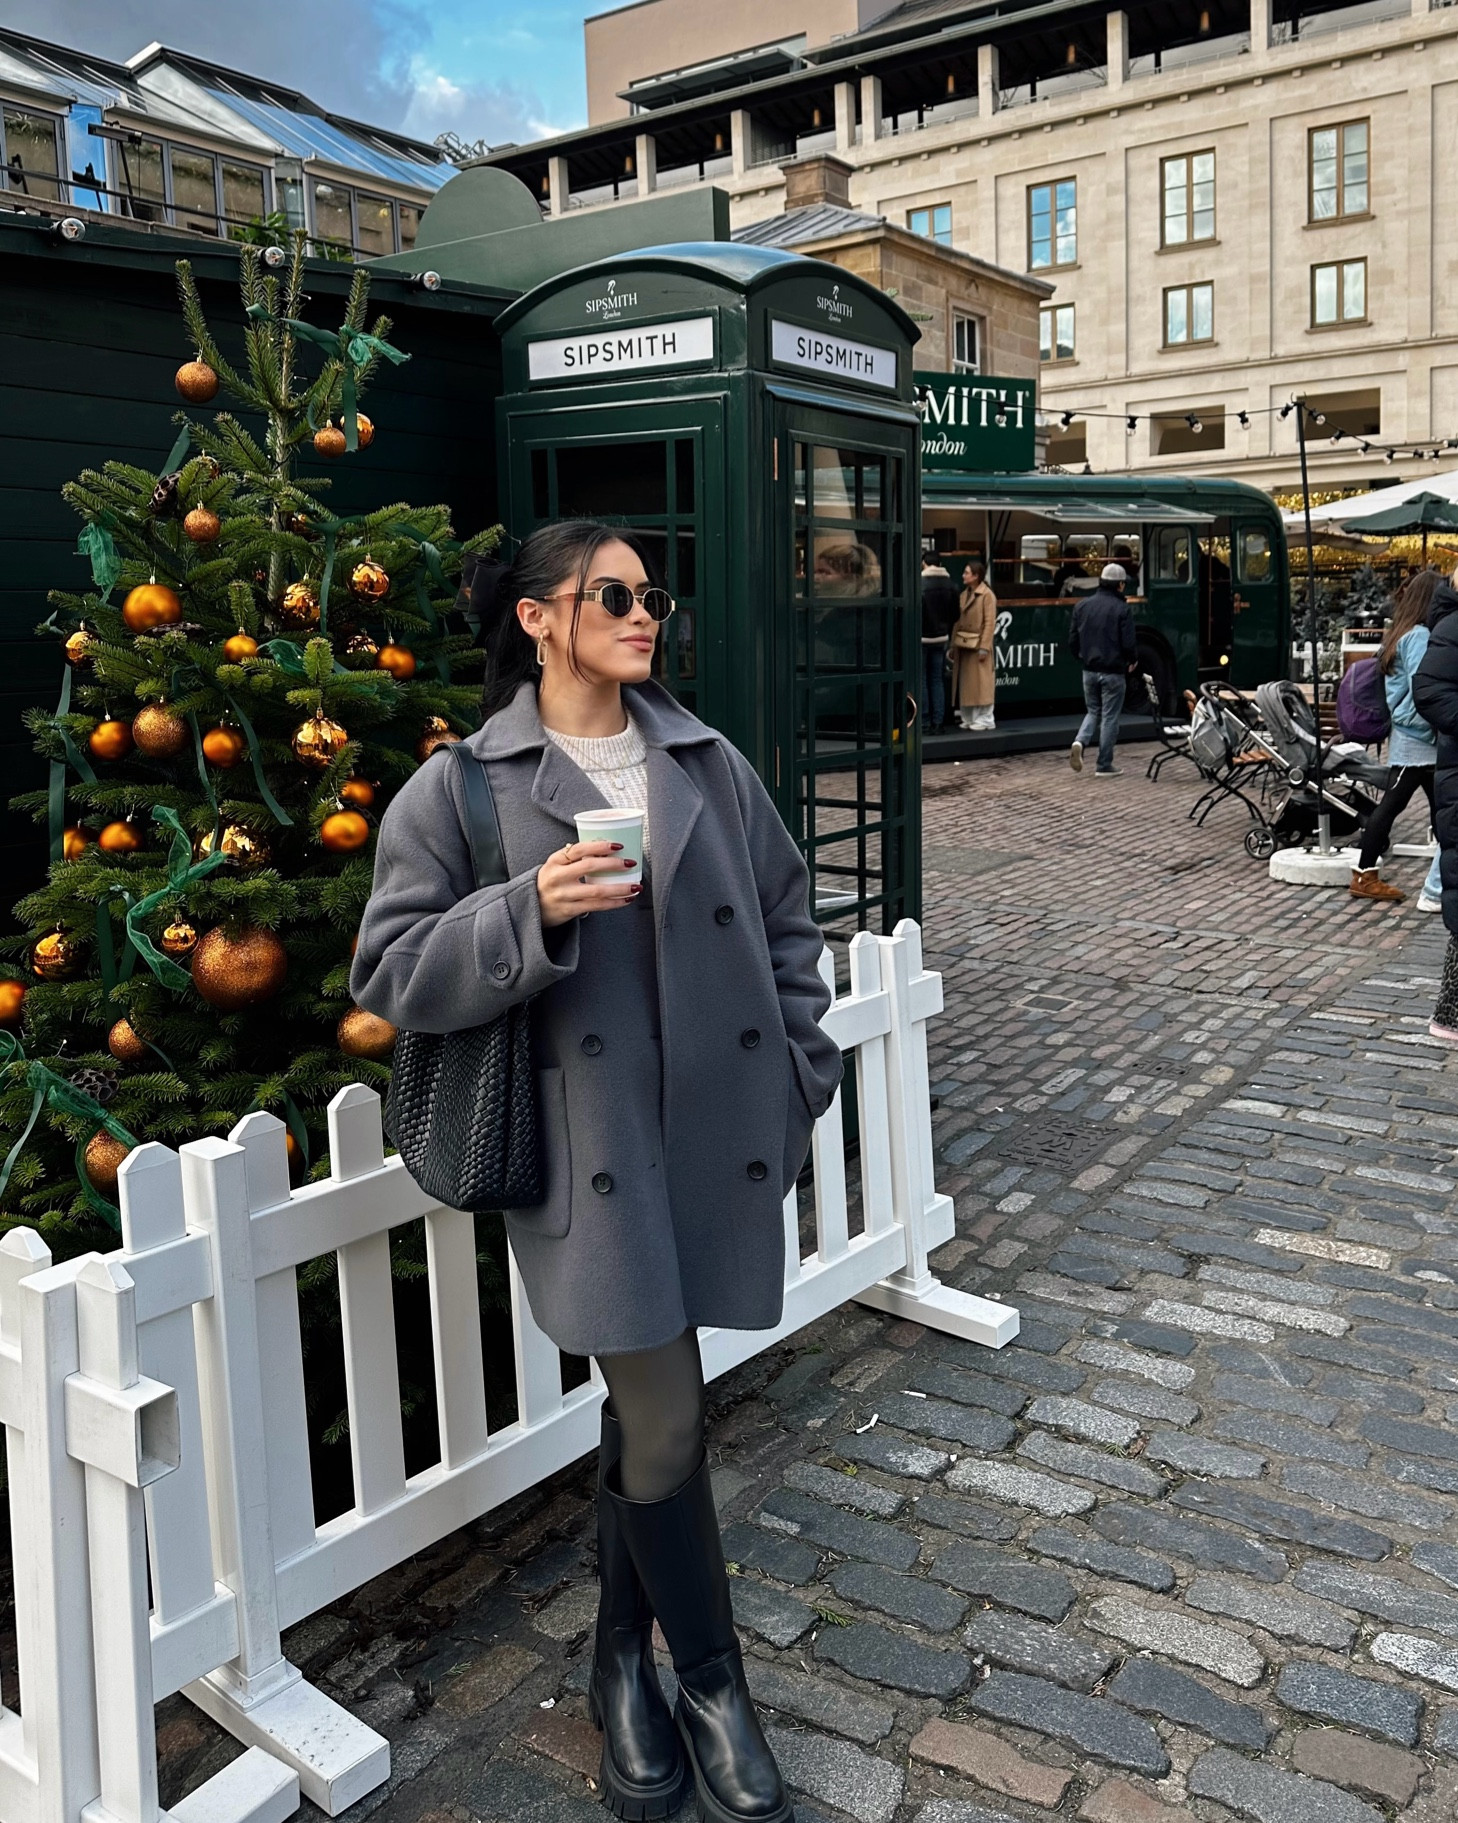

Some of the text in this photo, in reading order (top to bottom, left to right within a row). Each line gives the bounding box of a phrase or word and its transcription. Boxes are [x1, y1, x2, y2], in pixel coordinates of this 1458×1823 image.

[585, 292, 638, 313] SIPSMITH
[816, 295, 853, 318] SIPSMITH
[564, 332, 676, 367] SIPSMITH
[797, 336, 874, 375] SIPSMITH
